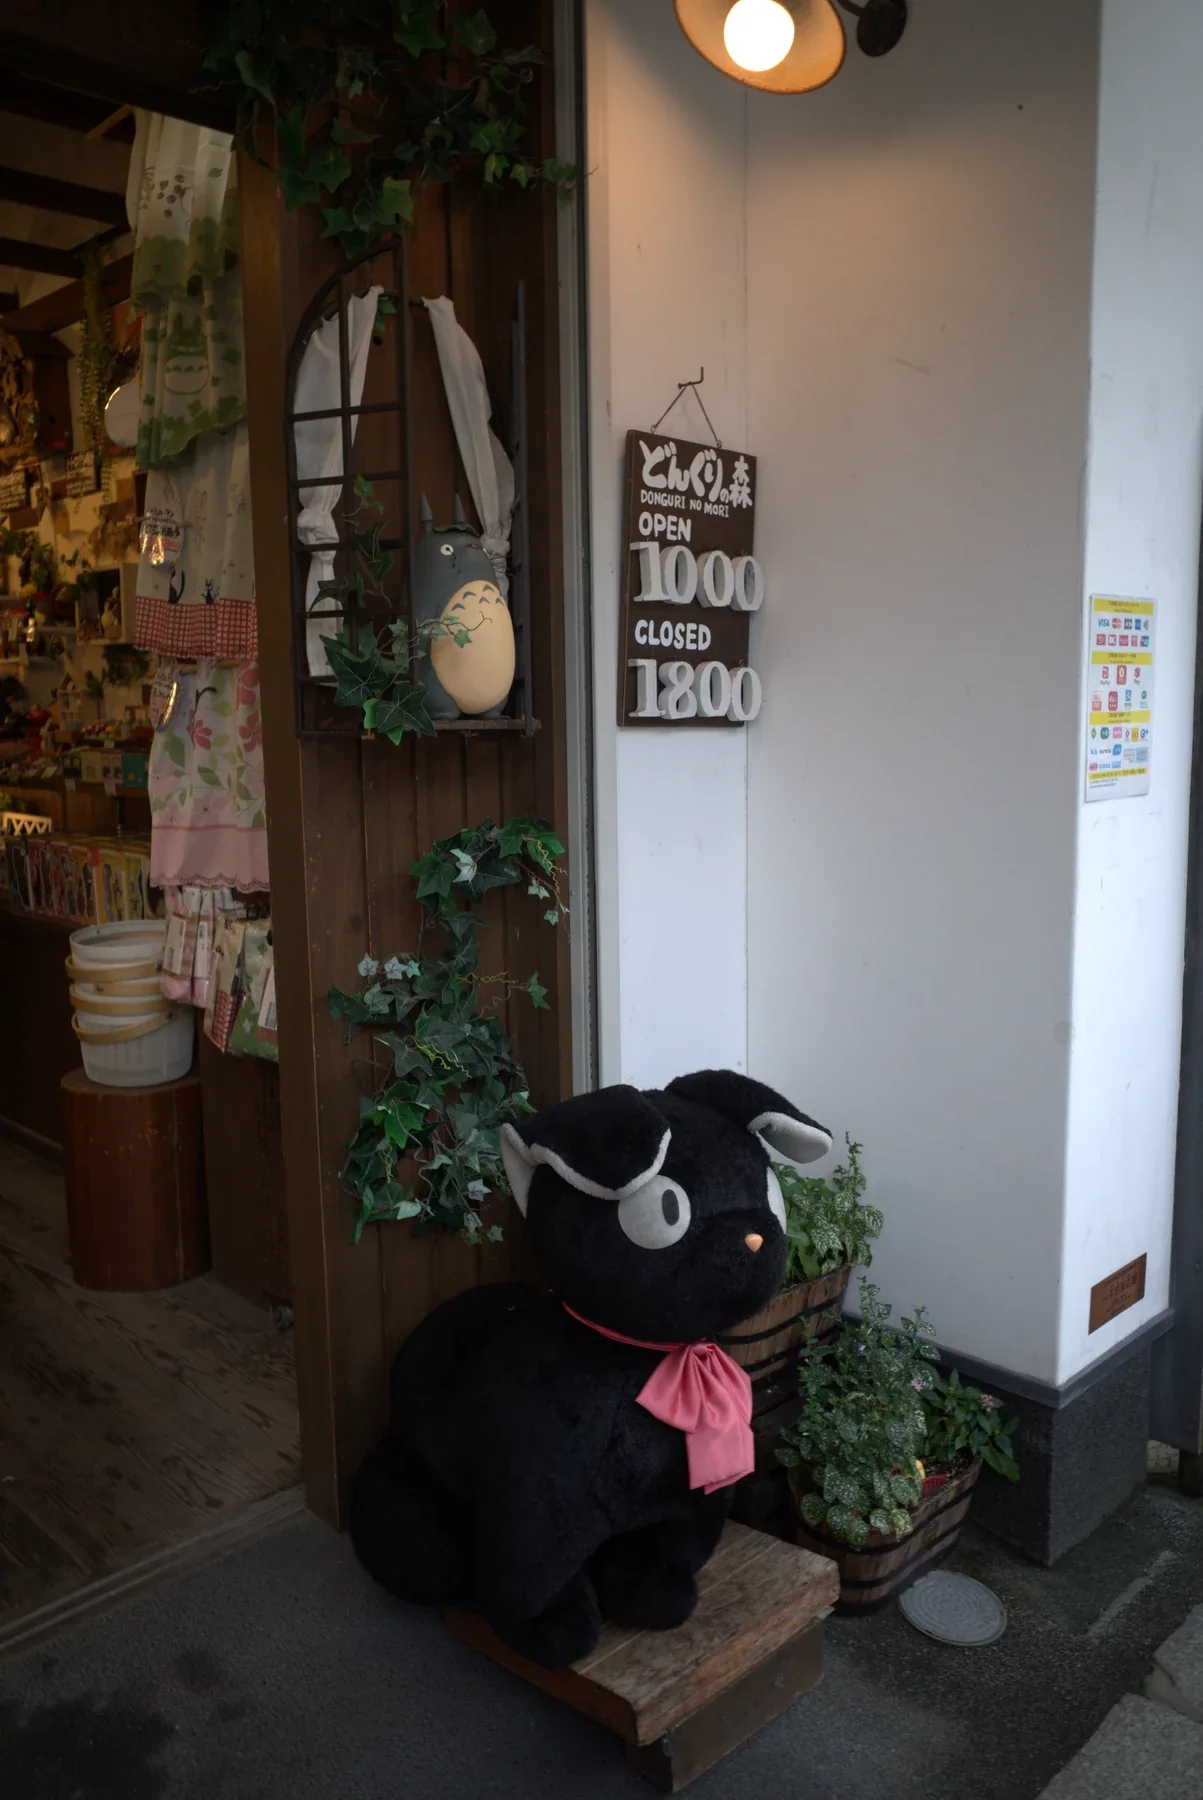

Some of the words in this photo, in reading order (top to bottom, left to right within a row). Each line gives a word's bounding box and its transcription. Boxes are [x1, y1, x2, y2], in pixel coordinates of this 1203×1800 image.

[639, 440, 753, 509] どんぐりの森
[640, 489, 686, 509] DONGURI
[689, 499, 703, 511] NO
[704, 502, 730, 518] MORI
[638, 511, 692, 542] OPEN
[634, 619, 712, 651] CLOSED
[1097, 618, 1110, 627] VISA
